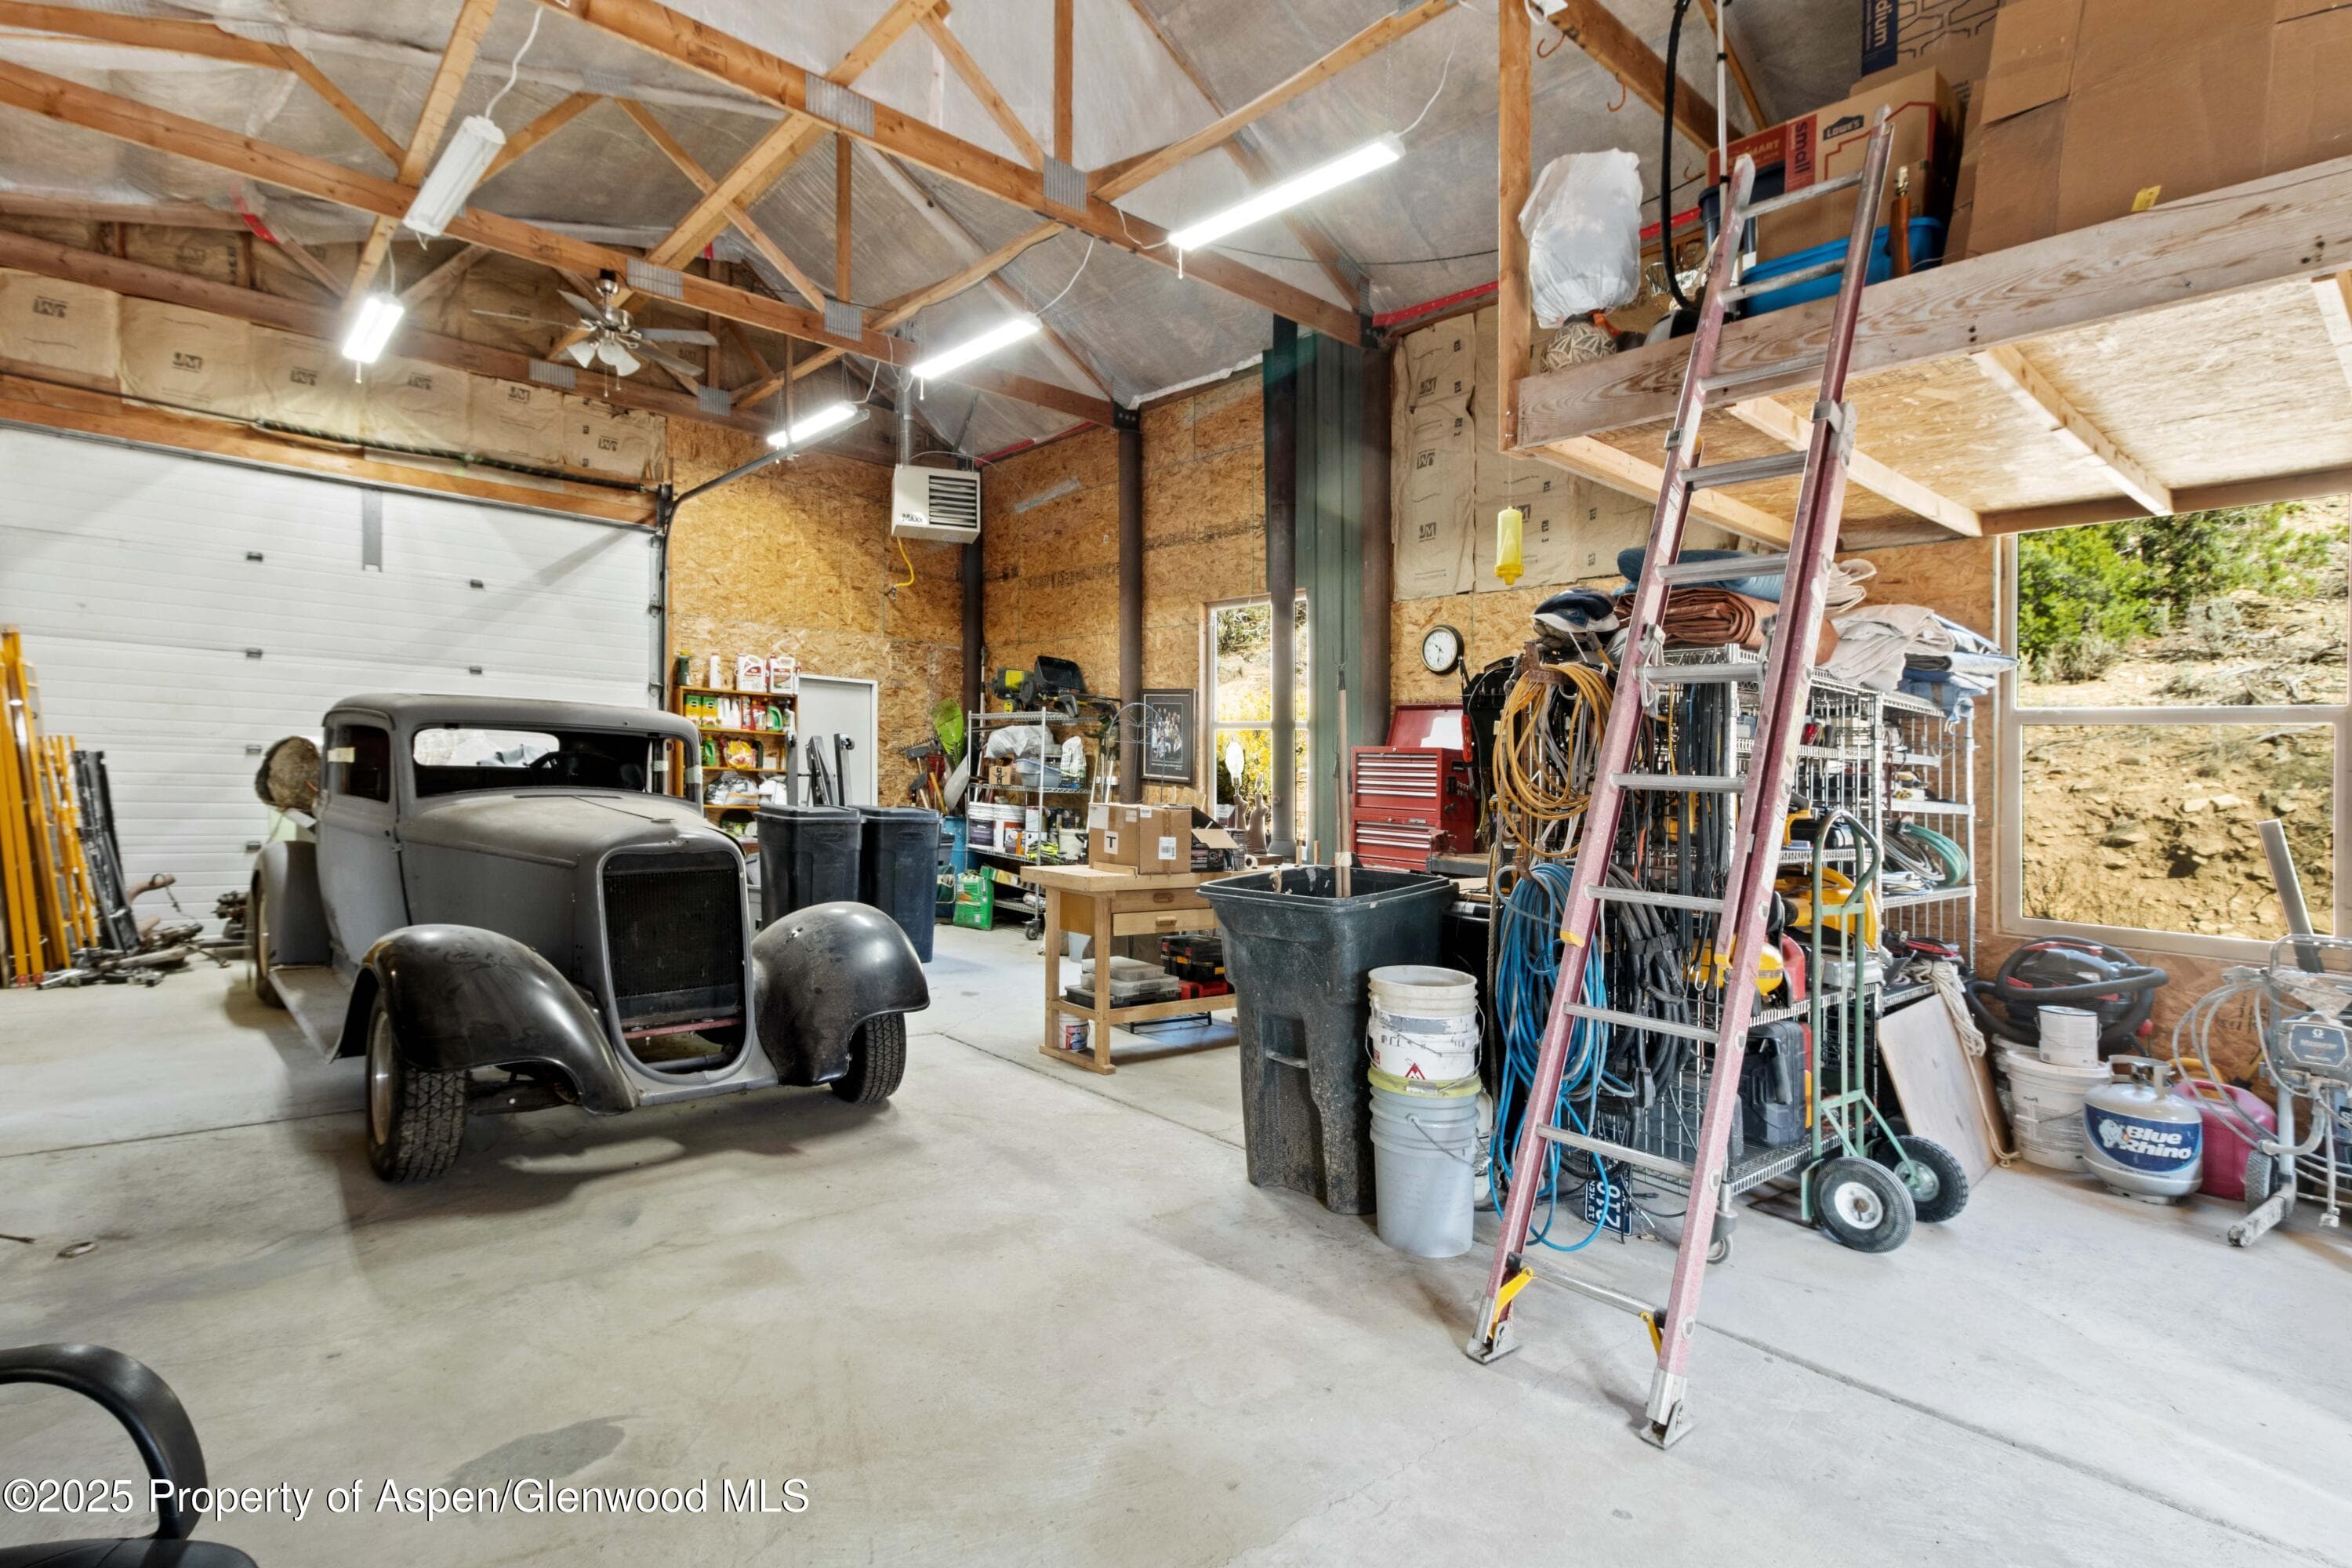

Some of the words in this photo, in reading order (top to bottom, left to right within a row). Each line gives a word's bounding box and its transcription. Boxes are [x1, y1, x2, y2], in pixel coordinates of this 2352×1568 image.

[1826, 118, 1860, 138] LOWE'S
[1795, 122, 1810, 174] small
[1106, 836, 1116, 848] T
[2126, 1125, 2183, 1145] Blue
[2120, 1139, 2192, 1160] Rhino
